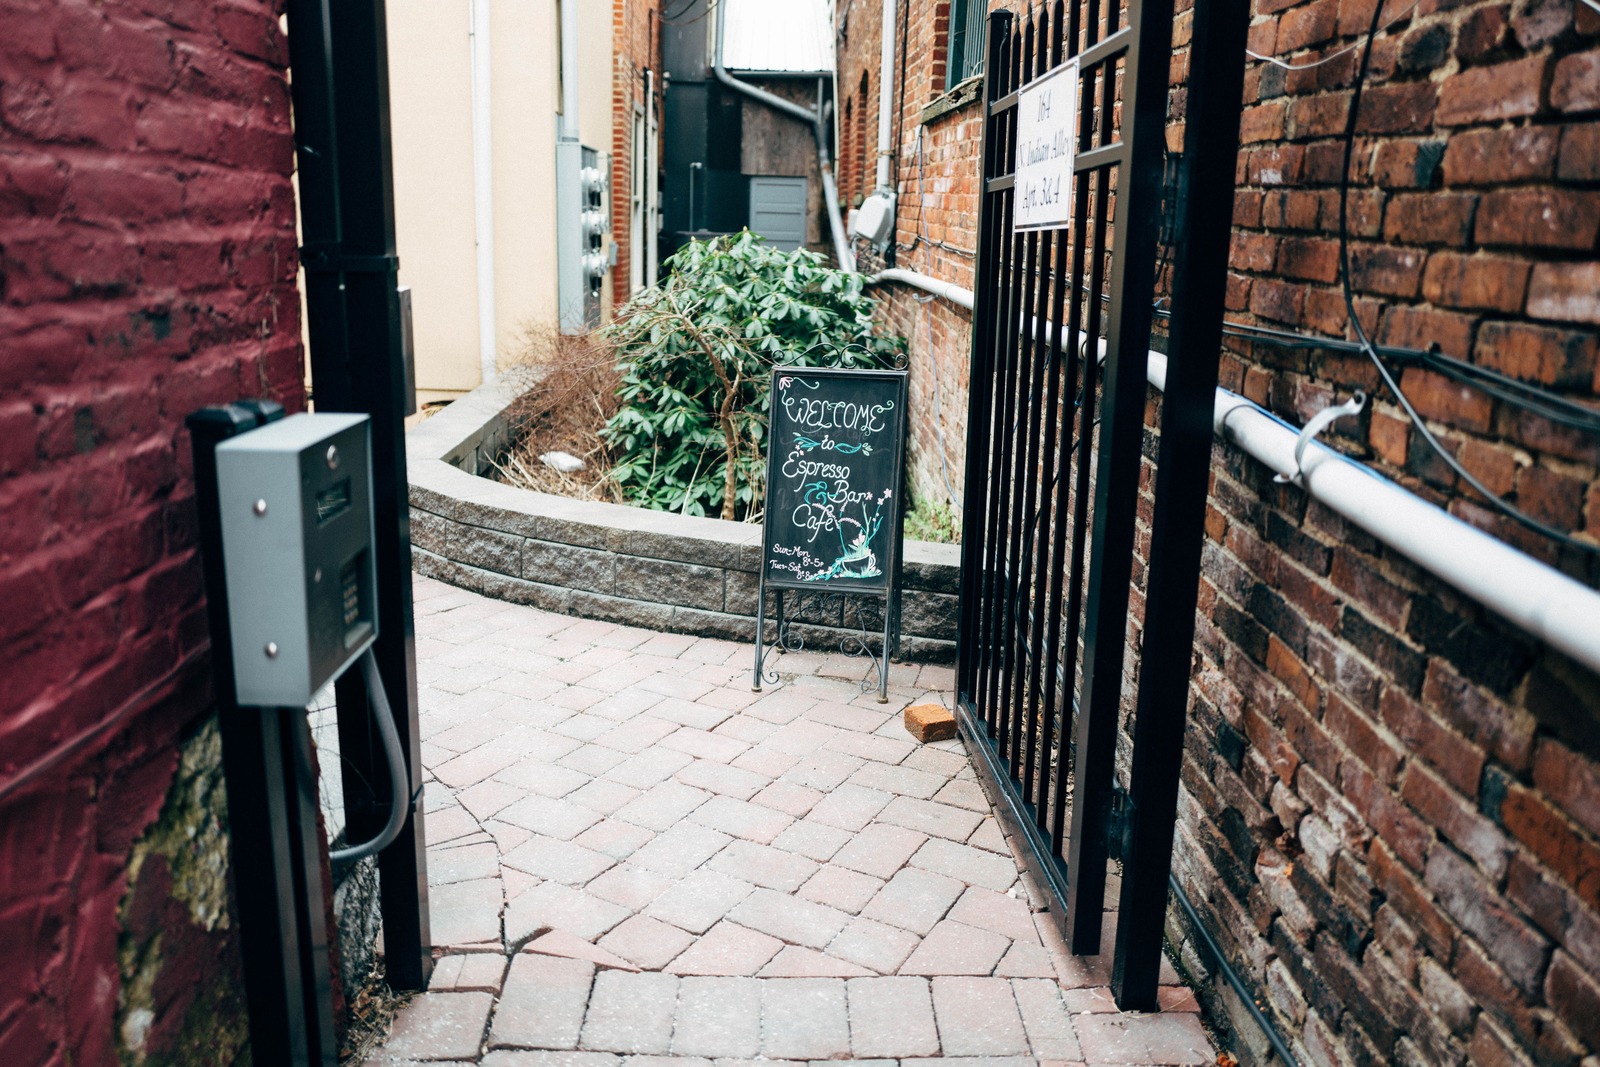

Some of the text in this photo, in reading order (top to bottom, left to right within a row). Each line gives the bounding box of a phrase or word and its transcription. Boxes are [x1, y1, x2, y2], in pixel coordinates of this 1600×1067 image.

[1037, 88, 1052, 122] 164
[1027, 137, 1050, 167] Indian
[1050, 127, 1071, 164] Alley
[1022, 179, 1038, 218] Apt.
[784, 397, 893, 434] WELCOME
[821, 434, 835, 450] to
[782, 450, 851, 492] Espresso
[827, 479, 866, 504] Bar
[792, 503, 835, 543] Cafe
[772, 543, 811, 558] Sun-Mon
